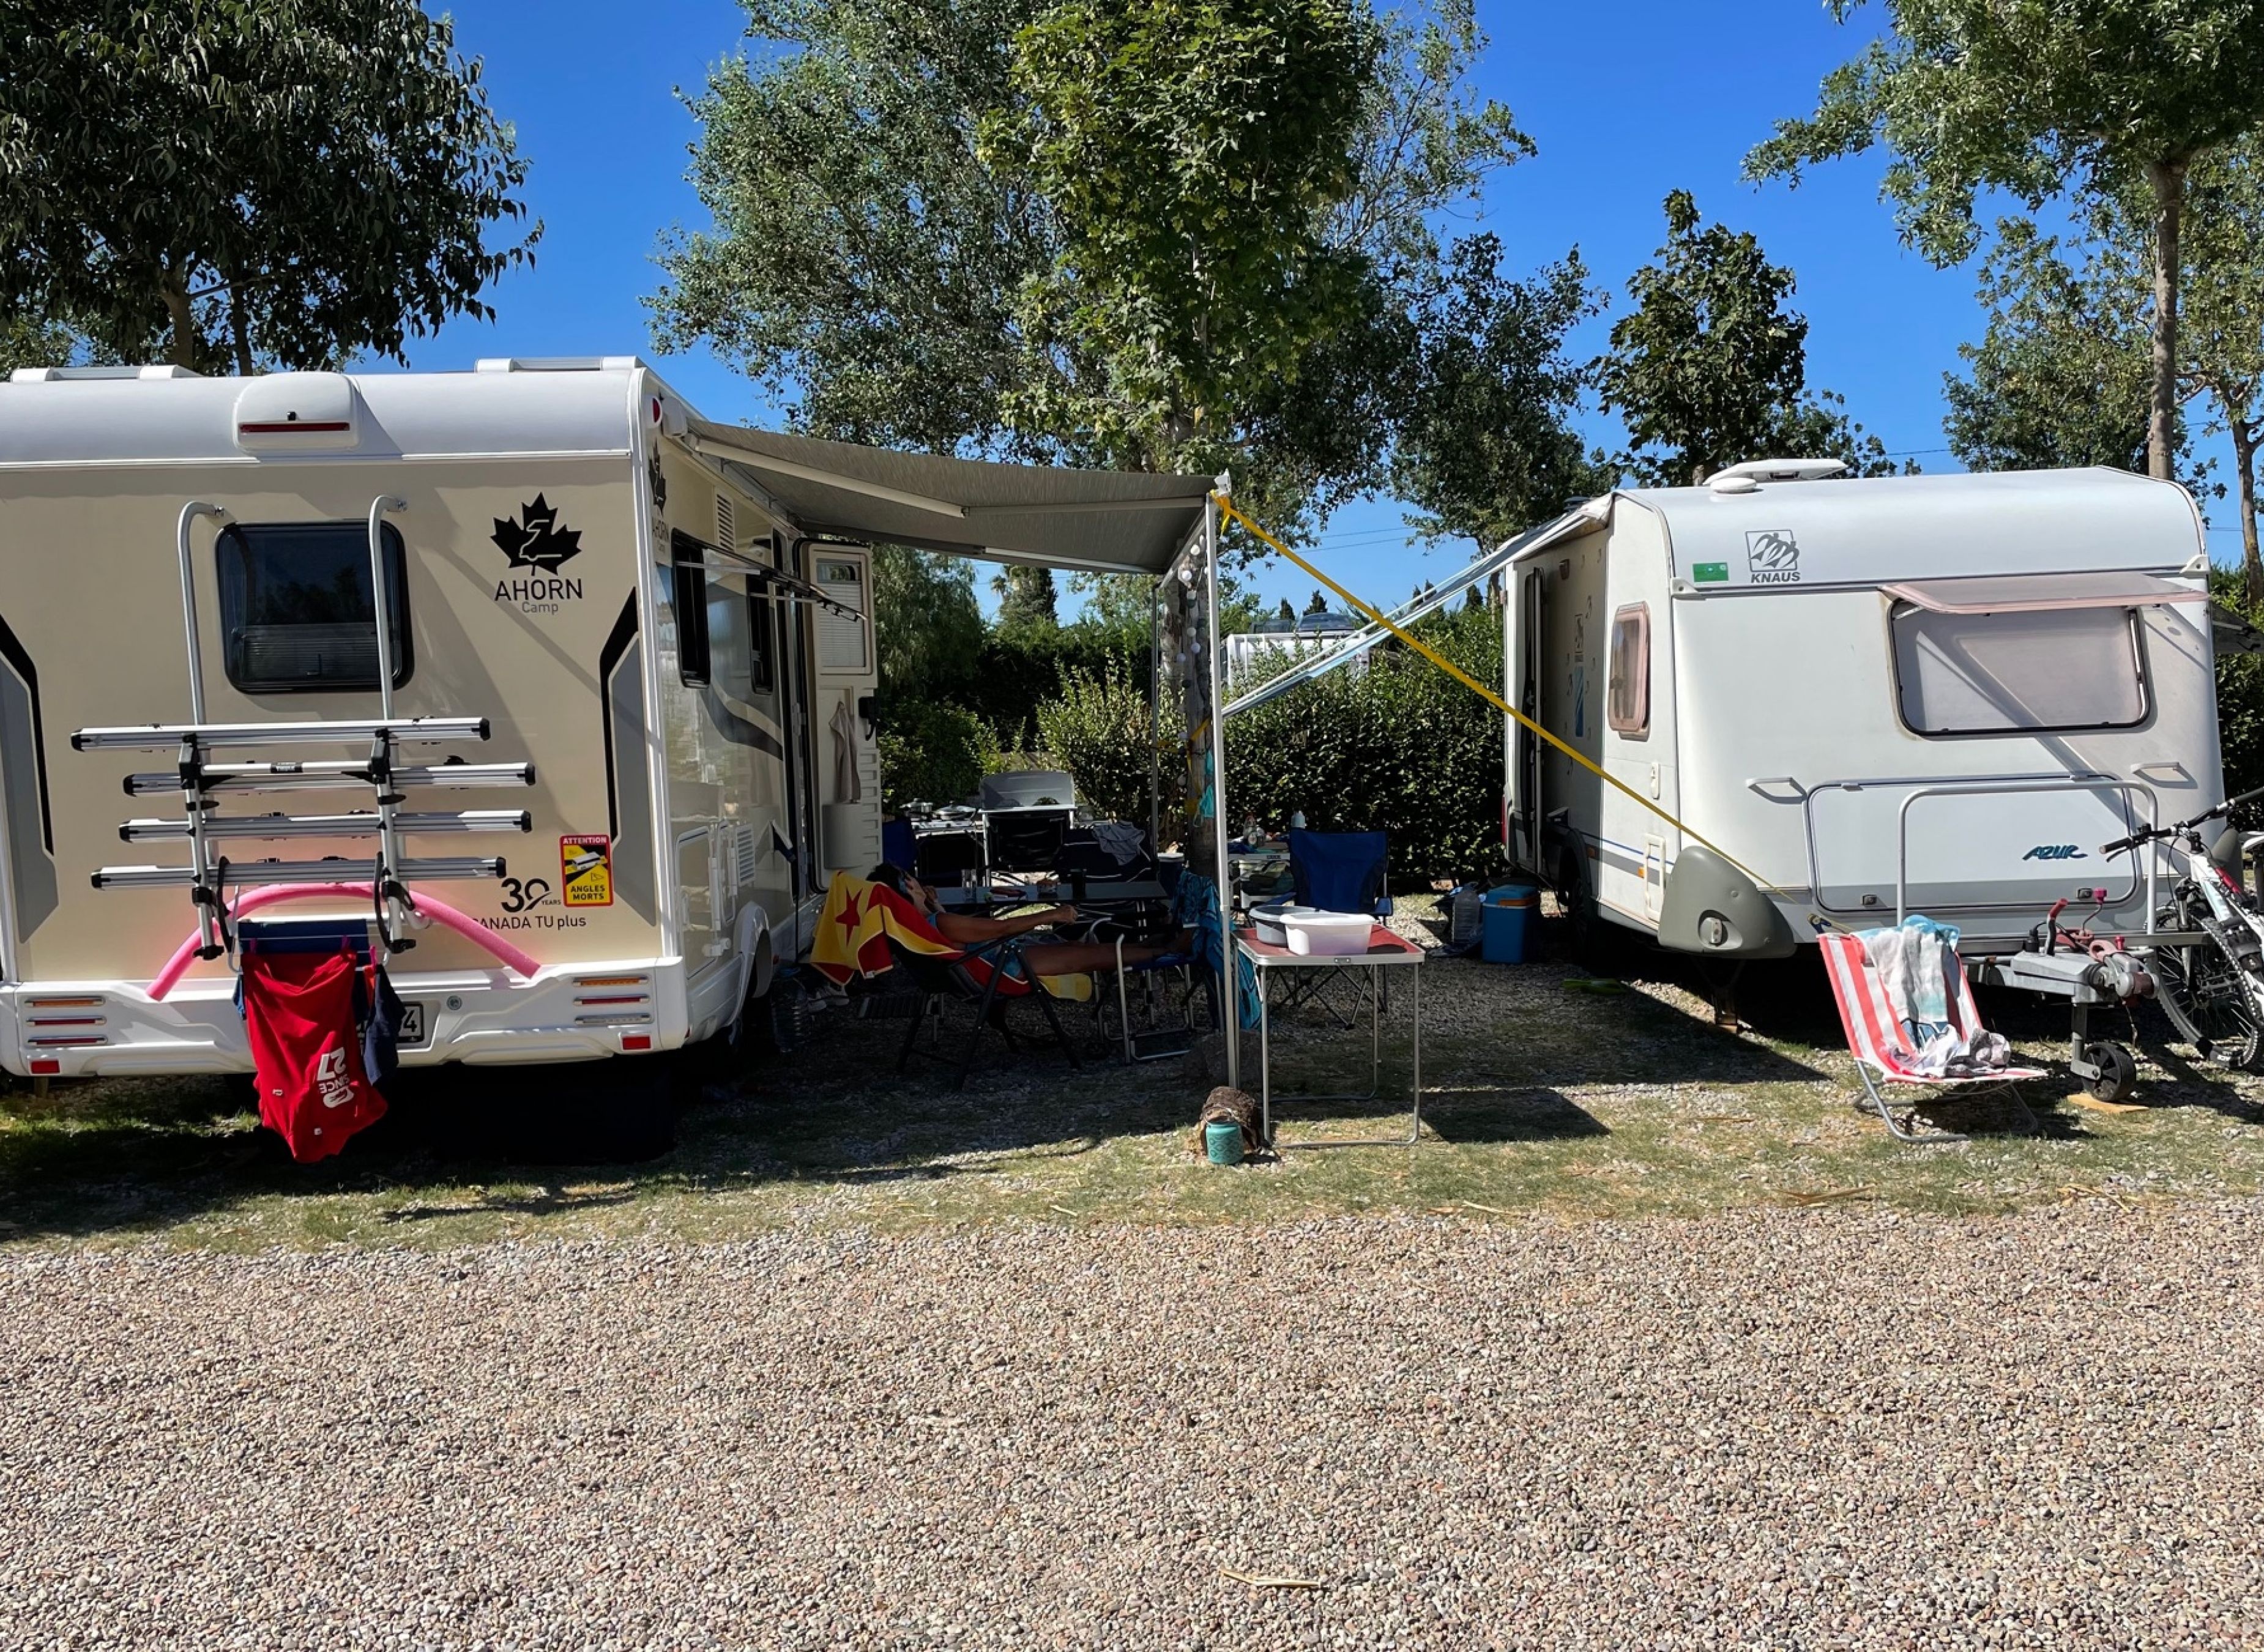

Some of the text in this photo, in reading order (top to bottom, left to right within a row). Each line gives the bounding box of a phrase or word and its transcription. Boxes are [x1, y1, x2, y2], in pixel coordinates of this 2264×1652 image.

[1751, 571, 1801, 584] KNAUS
[494, 578, 583, 601] AHORN
[522, 601, 559, 615] Camp
[2022, 844, 2088, 860] AZUR
[535, 915, 554, 928] TU
[557, 915, 586, 931] plus
